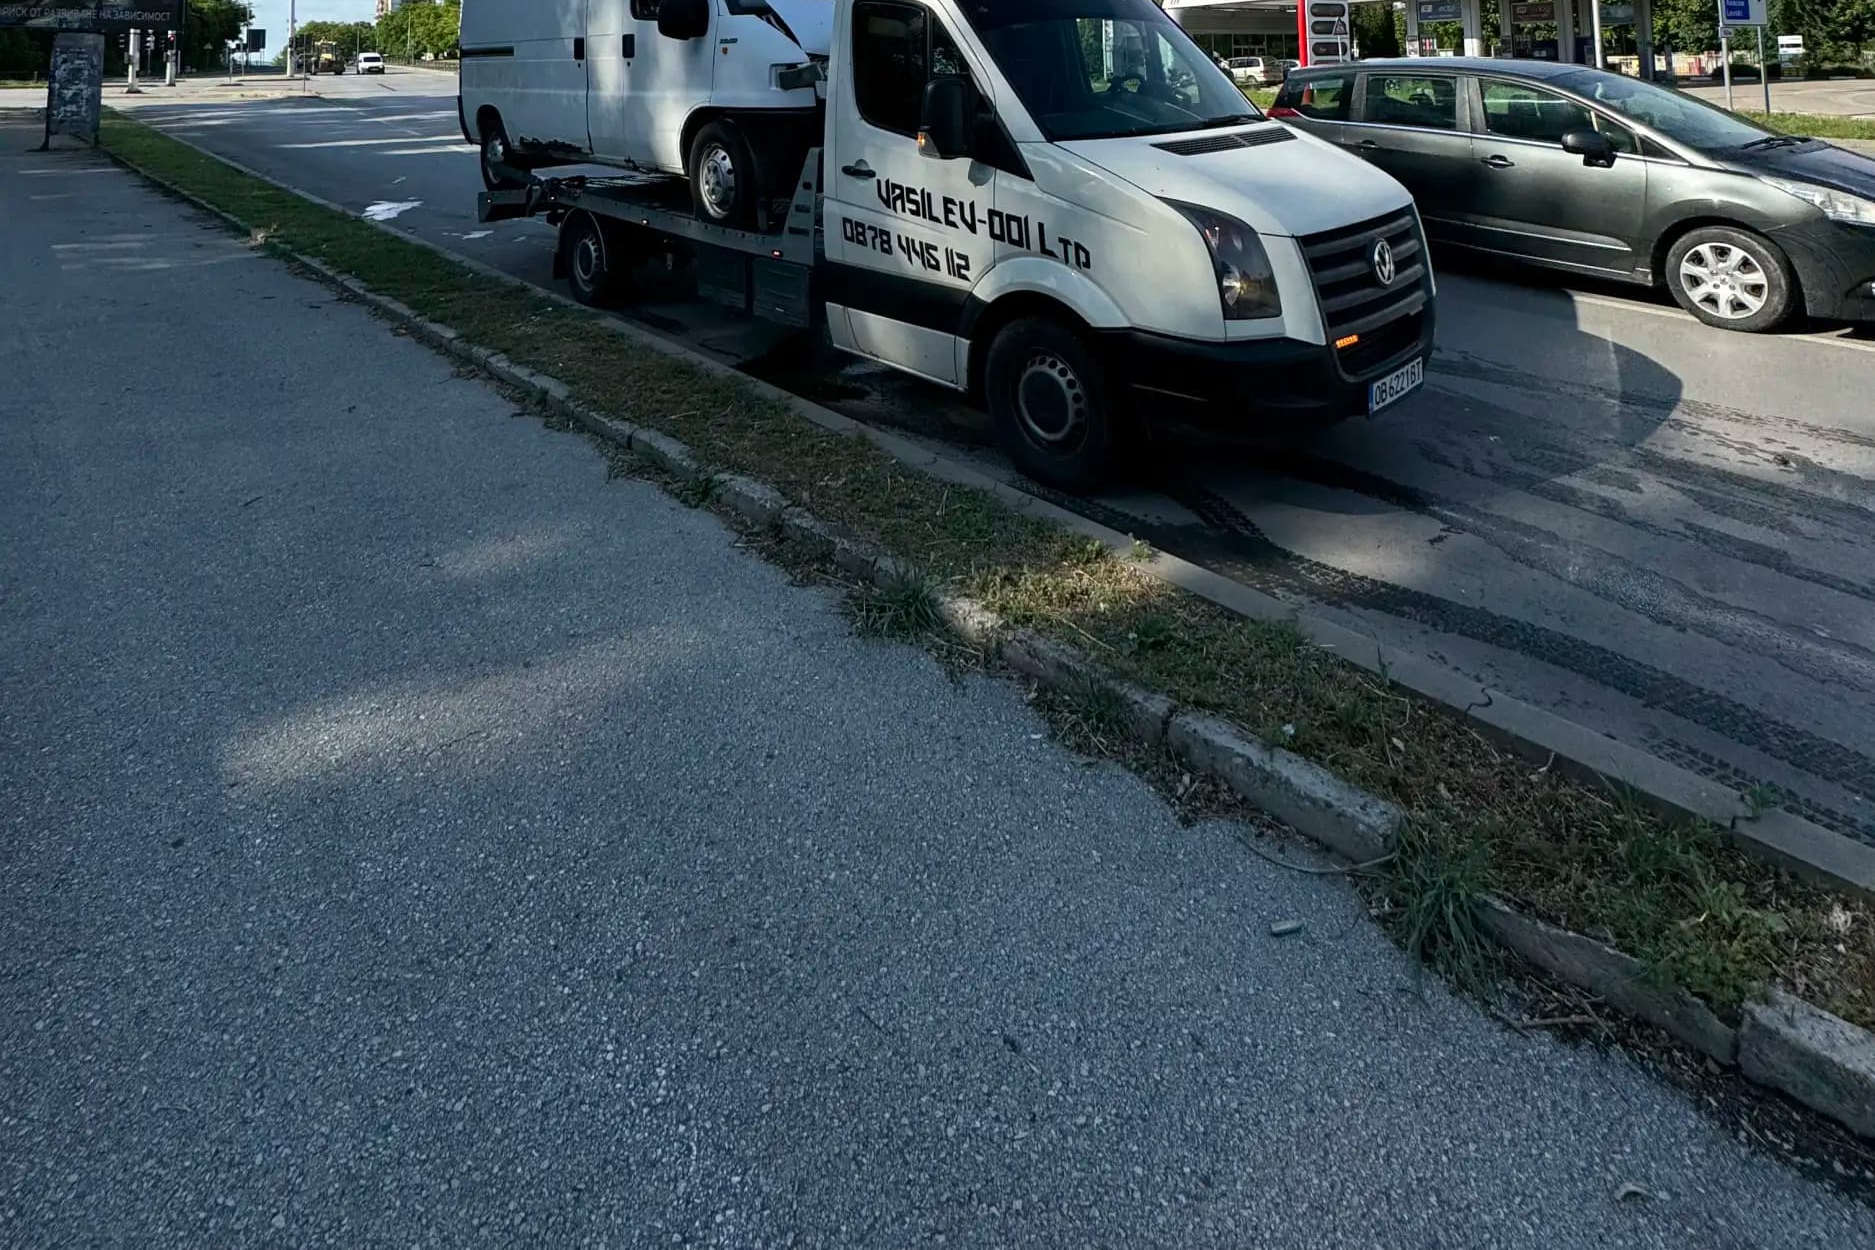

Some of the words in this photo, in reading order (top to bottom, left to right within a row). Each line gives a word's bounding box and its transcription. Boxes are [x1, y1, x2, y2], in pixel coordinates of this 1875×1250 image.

[113, 9, 171, 22] ЗАВИСИМОСТ
[841, 216, 893, 256] 0878
[896, 233, 941, 271] 445
[945, 246, 972, 282] 112
[1374, 381, 1388, 406] OB
[1389, 363, 1410, 396] 6221
[1410, 360, 1422, 384] BT
